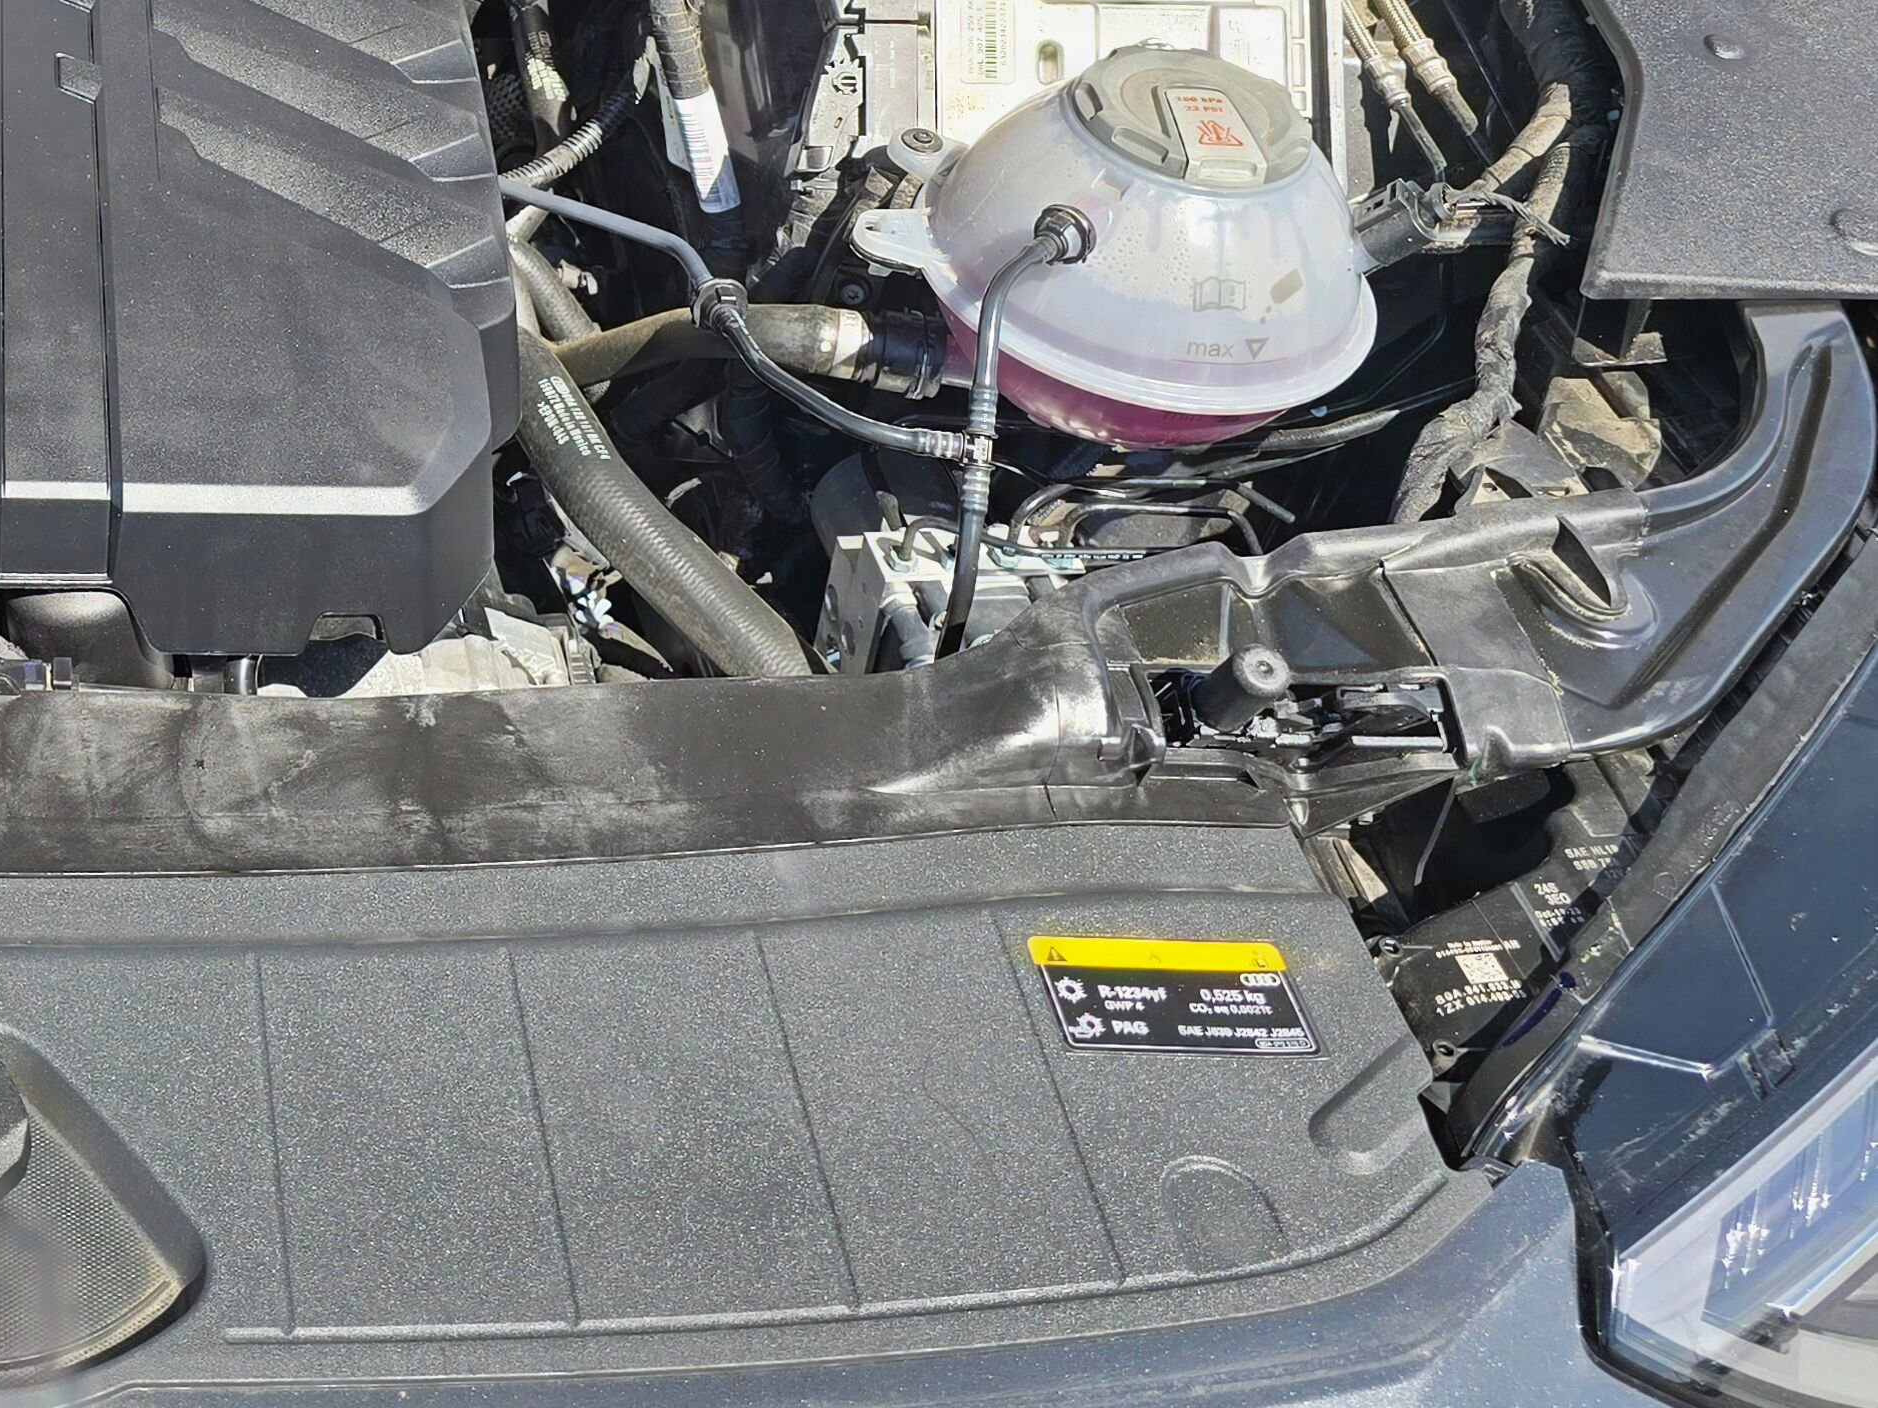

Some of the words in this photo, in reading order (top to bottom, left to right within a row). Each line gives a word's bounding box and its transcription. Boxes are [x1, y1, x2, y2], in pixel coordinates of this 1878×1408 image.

[1187, 341, 1234, 359] max
[1564, 847, 1589, 858] SAE
[1534, 882, 1559, 895] 24S
[1200, 989, 1243, 1003] 0,525
[1244, 990, 1267, 1004] kg
[1104, 1000, 1134, 1011] GWP
[1436, 999, 1464, 1016] 1ZX
[1111, 1019, 1150, 1036] PAG
[1177, 1025, 1204, 1036] SAE
